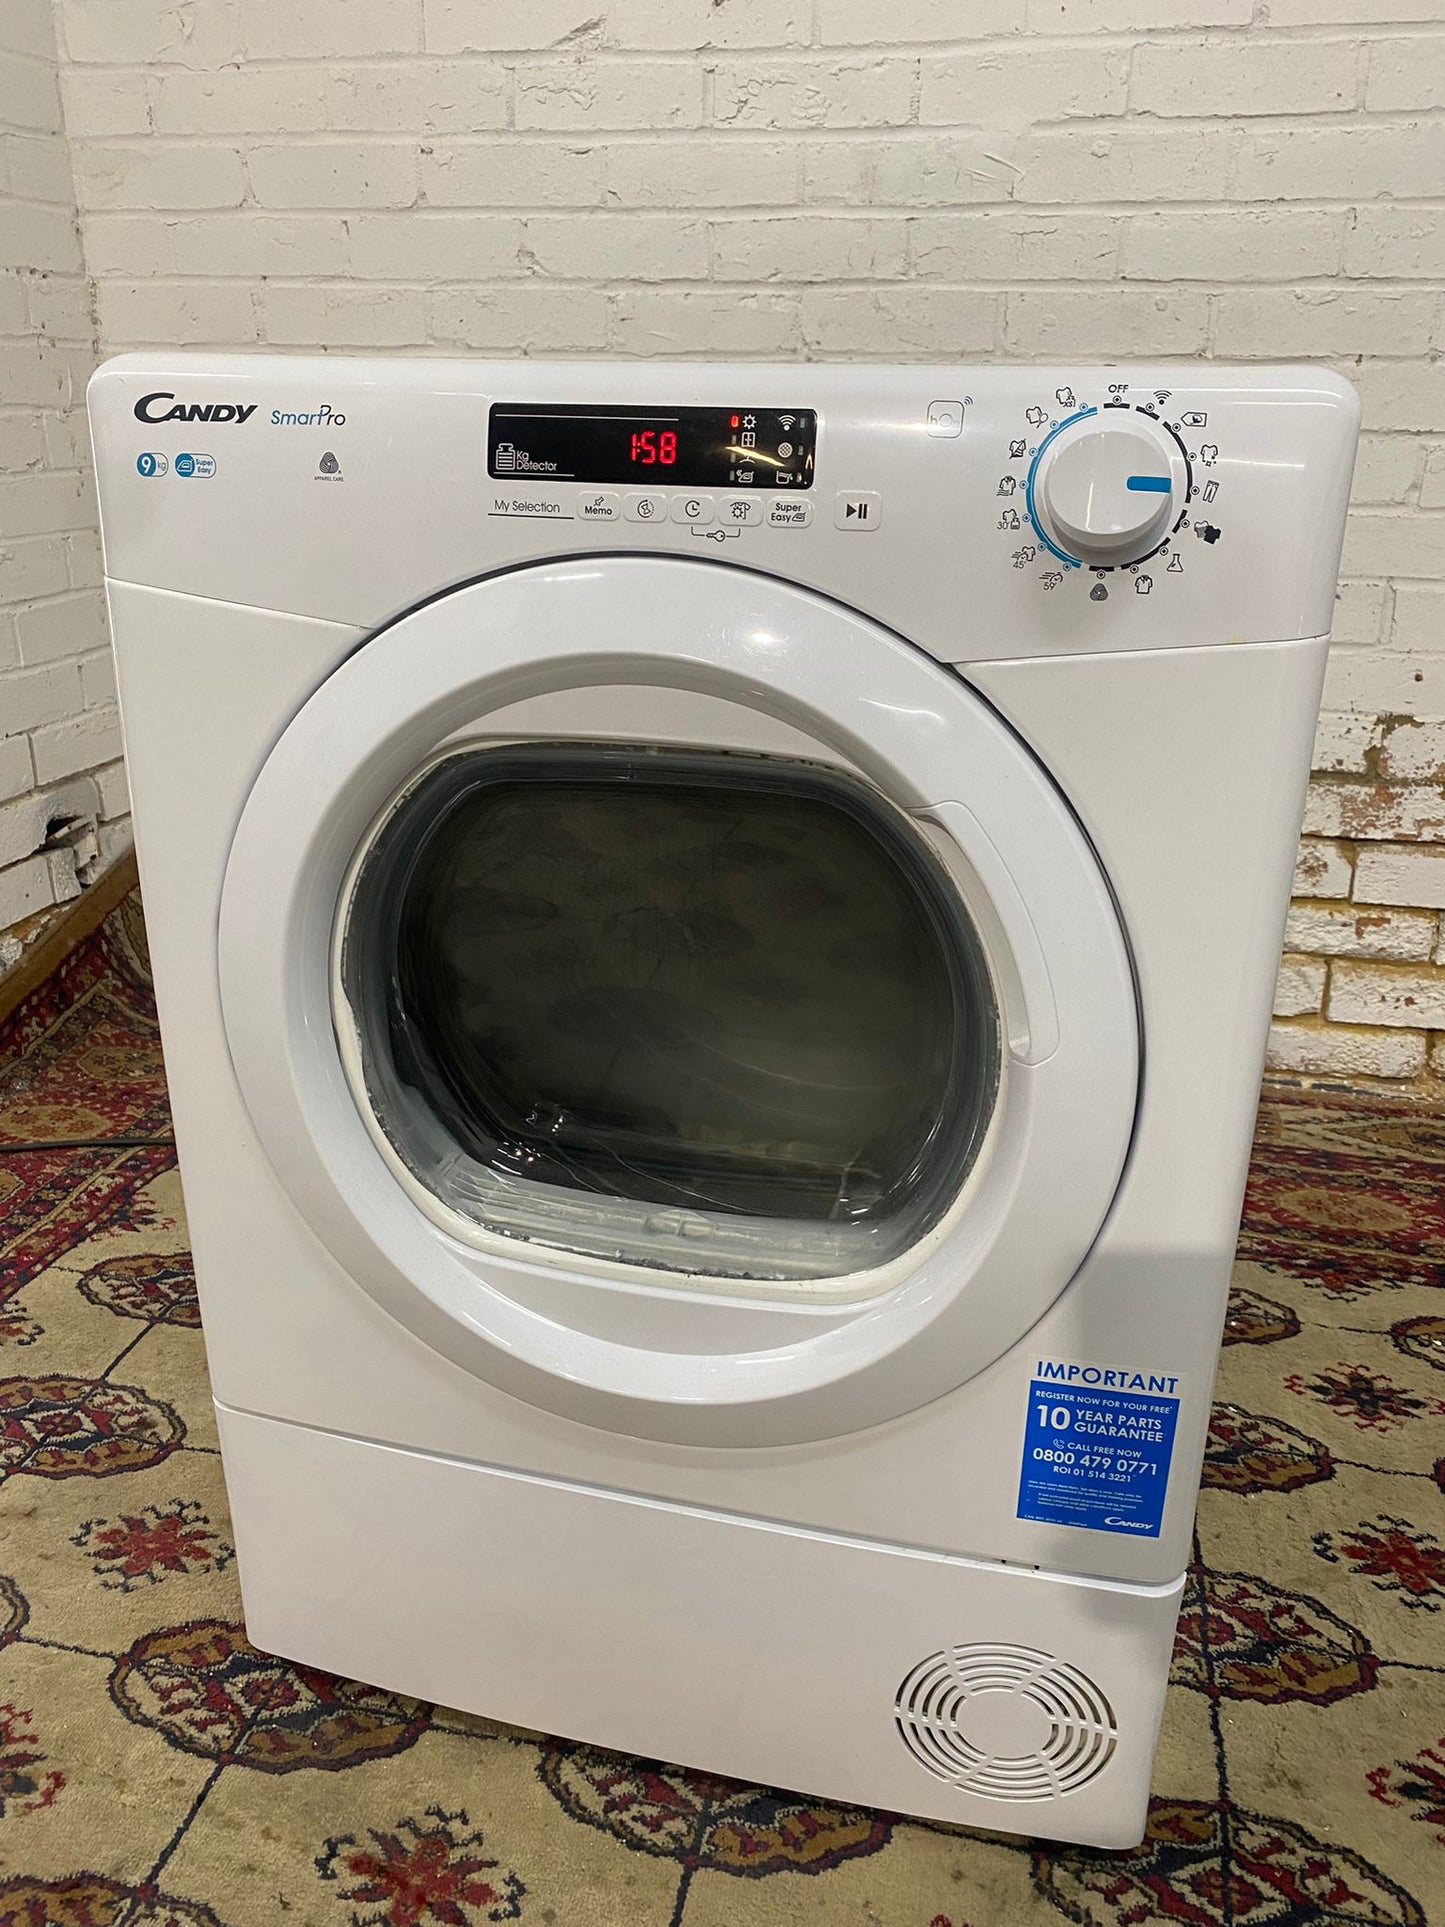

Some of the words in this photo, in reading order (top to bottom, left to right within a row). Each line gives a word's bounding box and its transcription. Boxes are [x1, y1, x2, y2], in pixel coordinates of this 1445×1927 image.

[1108, 384, 1129, 393] OFF
[134, 392, 258, 424] CANDY
[271, 404, 346, 426] SmartPro
[631, 430, 677, 465] 1:58
[196, 458, 213, 467] Super
[516, 450, 529, 461] Kg
[141, 456, 152, 474] 9
[158, 461, 167, 472] kg
[197, 466, 212, 475] Easy
[516, 460, 557, 471] Detector
[494, 500, 510, 512] My
[512, 501, 560, 513] Selection
[584, 505, 613, 515] Memo
[775, 502, 802, 513] Super
[771, 513, 792, 523] Easy
[1037, 1360, 1178, 1394] IMPORTANT
[1036, 1390, 1075, 1402] REGISTER
[1077, 1396, 1101, 1405] NOW
[1102, 1399, 1120, 1408] FOR
[1123, 1402, 1147, 1411] YOUR
[1037, 1404, 1071, 1430] 10
[1076, 1409, 1113, 1424] YEAR
[1118, 1415, 1162, 1430] PARTS
[1074, 1421, 1164, 1443] GUARANTEE
[1067, 1442, 1091, 1452] CALL
[1093, 1446, 1115, 1455] FREE
[1117, 1449, 1142, 1458] NOW
[1033, 1447, 1075, 1465] 0800
[1080, 1455, 1112, 1470] 479
[1117, 1460, 1158, 1476] 0771
[1053, 1465, 1071, 1475] ROI
[1073, 1469, 1085, 1477] 01
[1088, 1471, 1106, 1480] 514
[1104, 1516, 1154, 1530] CANDY
